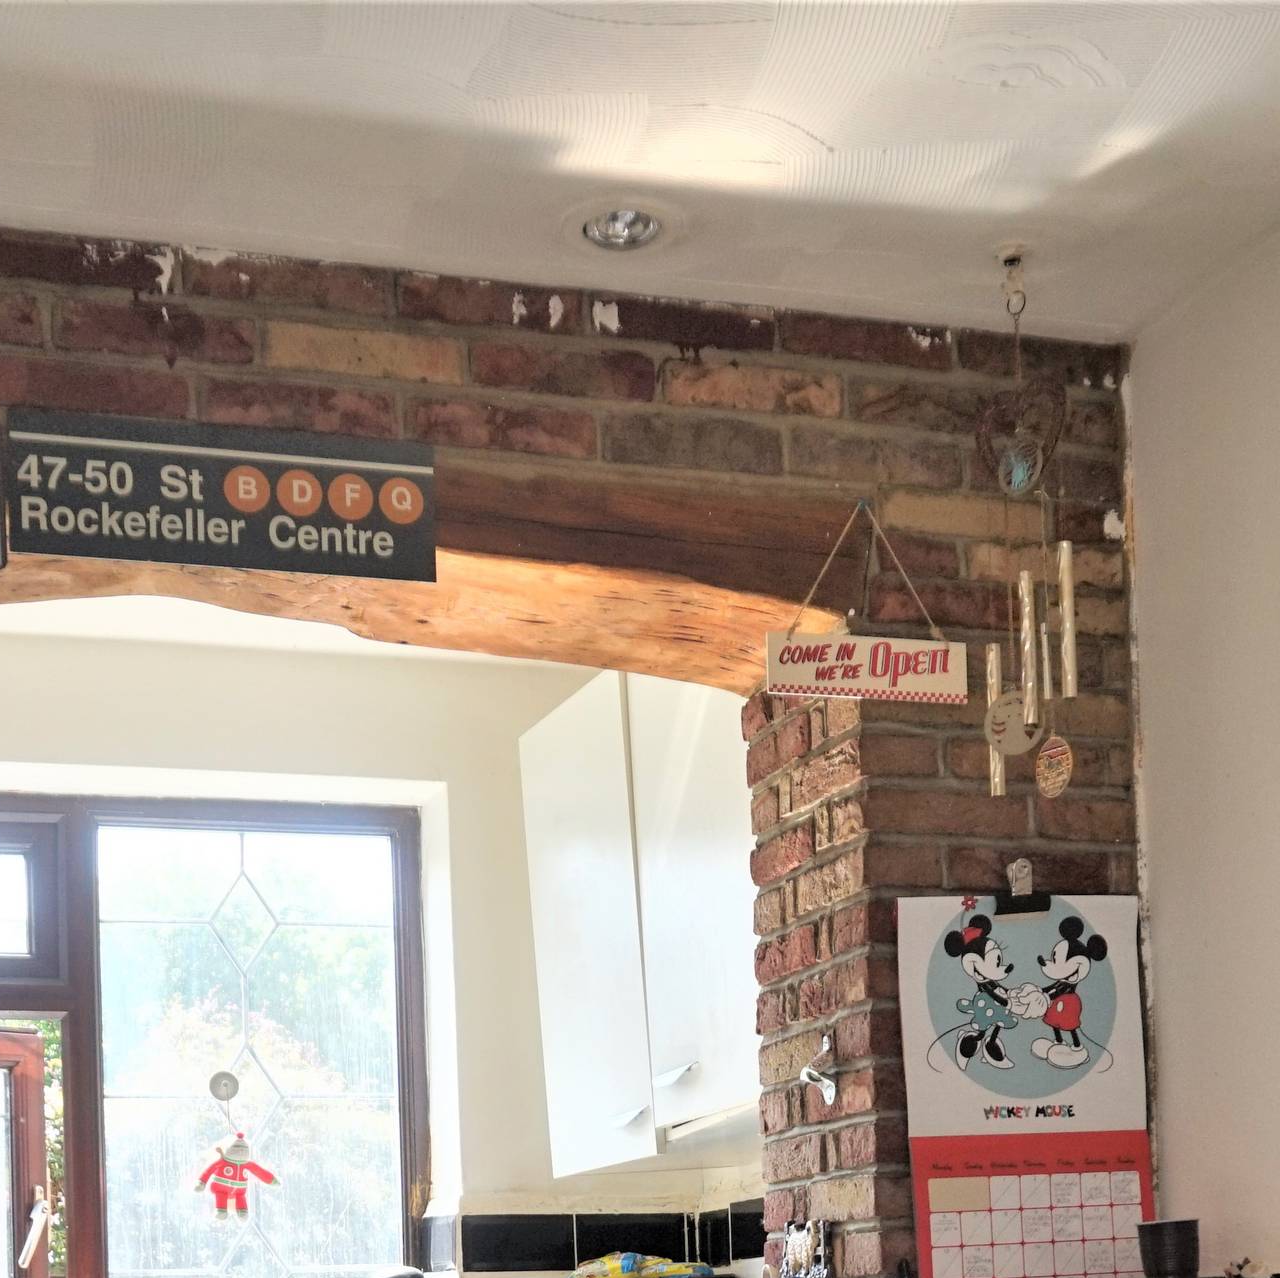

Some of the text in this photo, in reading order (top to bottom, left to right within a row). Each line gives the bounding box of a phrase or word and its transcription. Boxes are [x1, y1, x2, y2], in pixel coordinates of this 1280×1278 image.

[17, 453, 413, 511] 47-50 St B D F Q
[20, 495, 245, 545] Rockefeller
[269, 514, 395, 557] Centre
[779, 642, 857, 665] COME IN
[869, 641, 950, 688] Open
[815, 662, 864, 682] WE'RE
[983, 1104, 1076, 1120] MICKEY MOUSE
